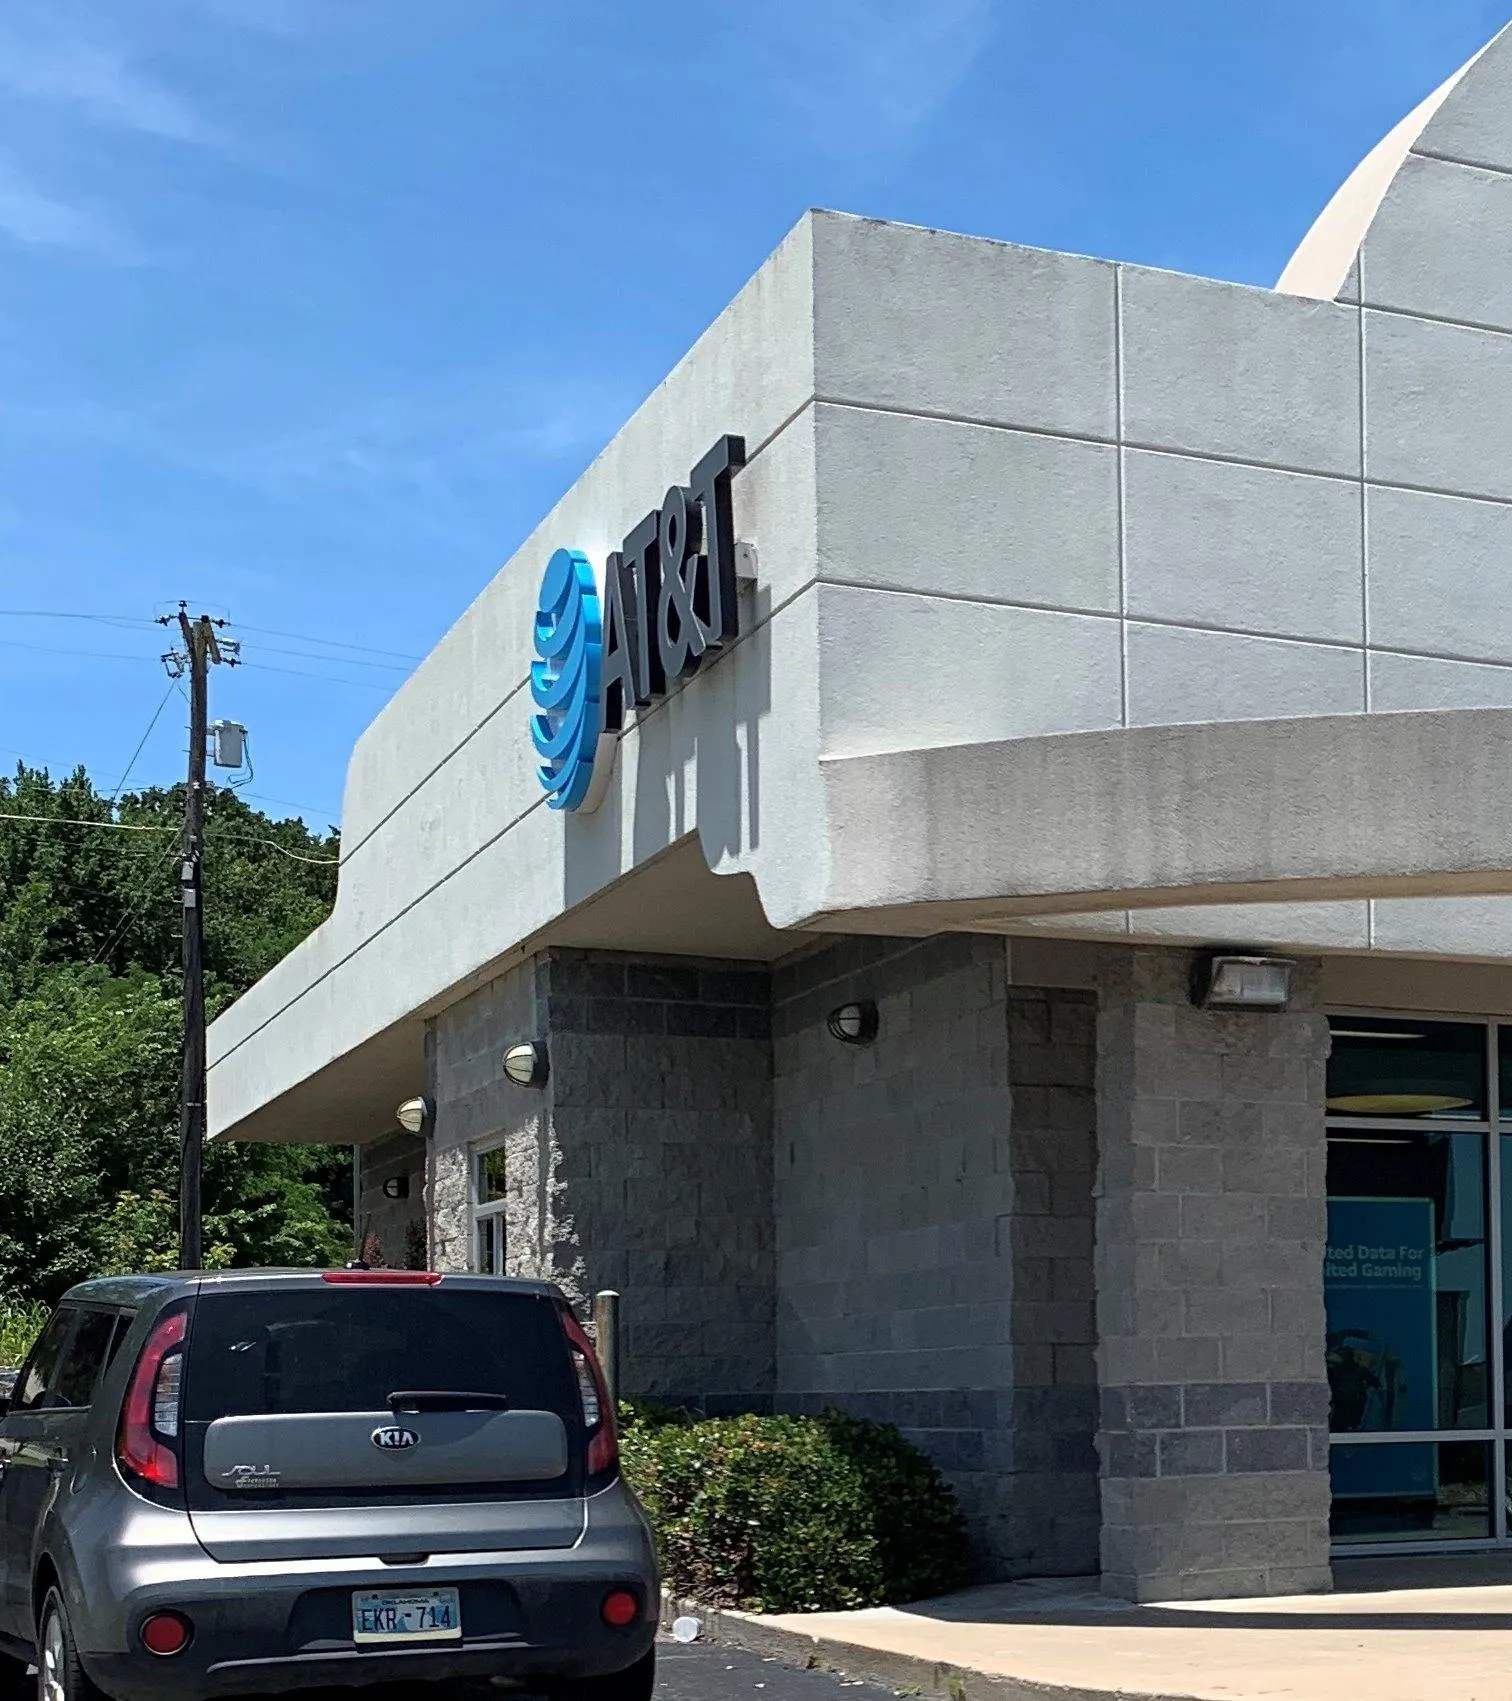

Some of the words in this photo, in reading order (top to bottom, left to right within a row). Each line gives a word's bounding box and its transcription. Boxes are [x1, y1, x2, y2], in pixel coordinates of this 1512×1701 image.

[601, 434, 746, 734] AT&T
[1357, 1244, 1396, 1260] Data
[1399, 1245, 1425, 1260] For
[1361, 1261, 1422, 1282] Gaming
[379, 1431, 414, 1446] KIA
[360, 1604, 451, 1632] EKR-714
